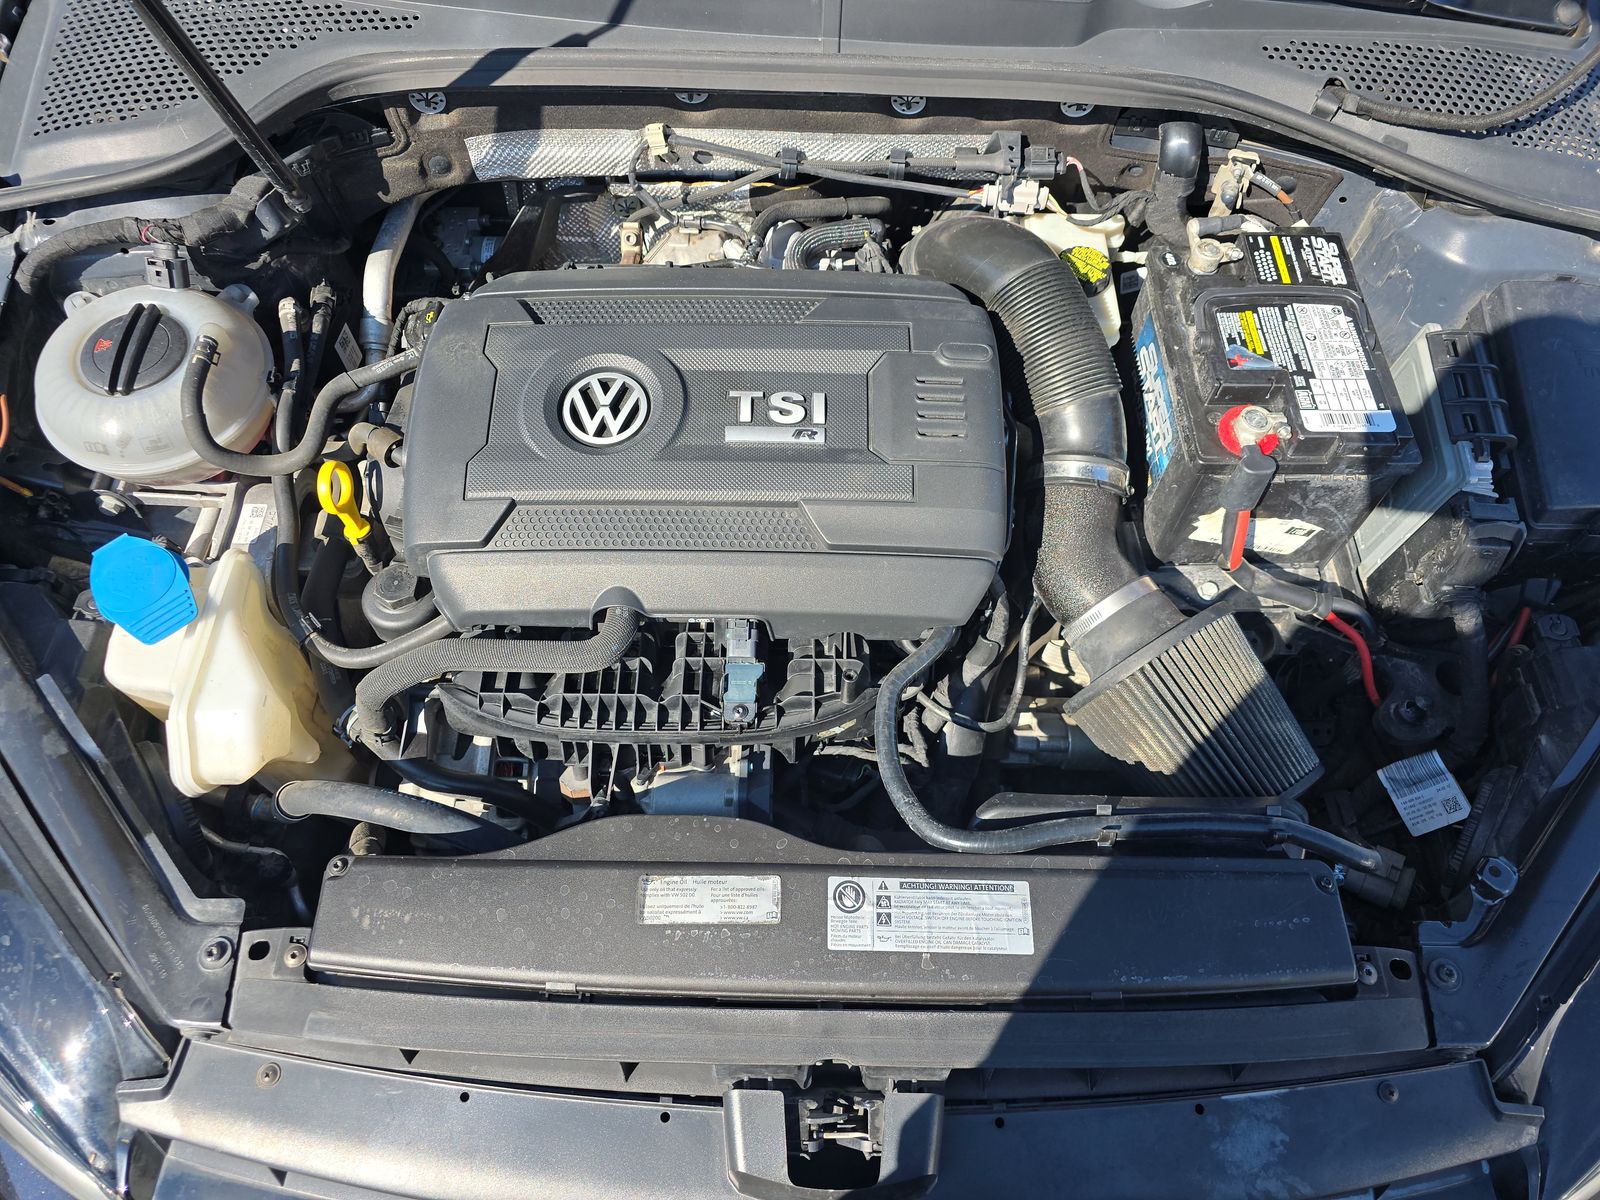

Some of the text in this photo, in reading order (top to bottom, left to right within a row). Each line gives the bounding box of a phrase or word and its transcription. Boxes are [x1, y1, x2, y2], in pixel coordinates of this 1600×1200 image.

[1301, 236, 1319, 276] PLATINUM
[1309, 236, 1334, 284] START
[1327, 242, 1348, 286] SUPER
[729, 390, 827, 426] TSI
[1147, 342, 1173, 444] SUPER
[902, 882, 937, 890] ACHTUNG!
[938, 883, 973, 891] WARNING!
